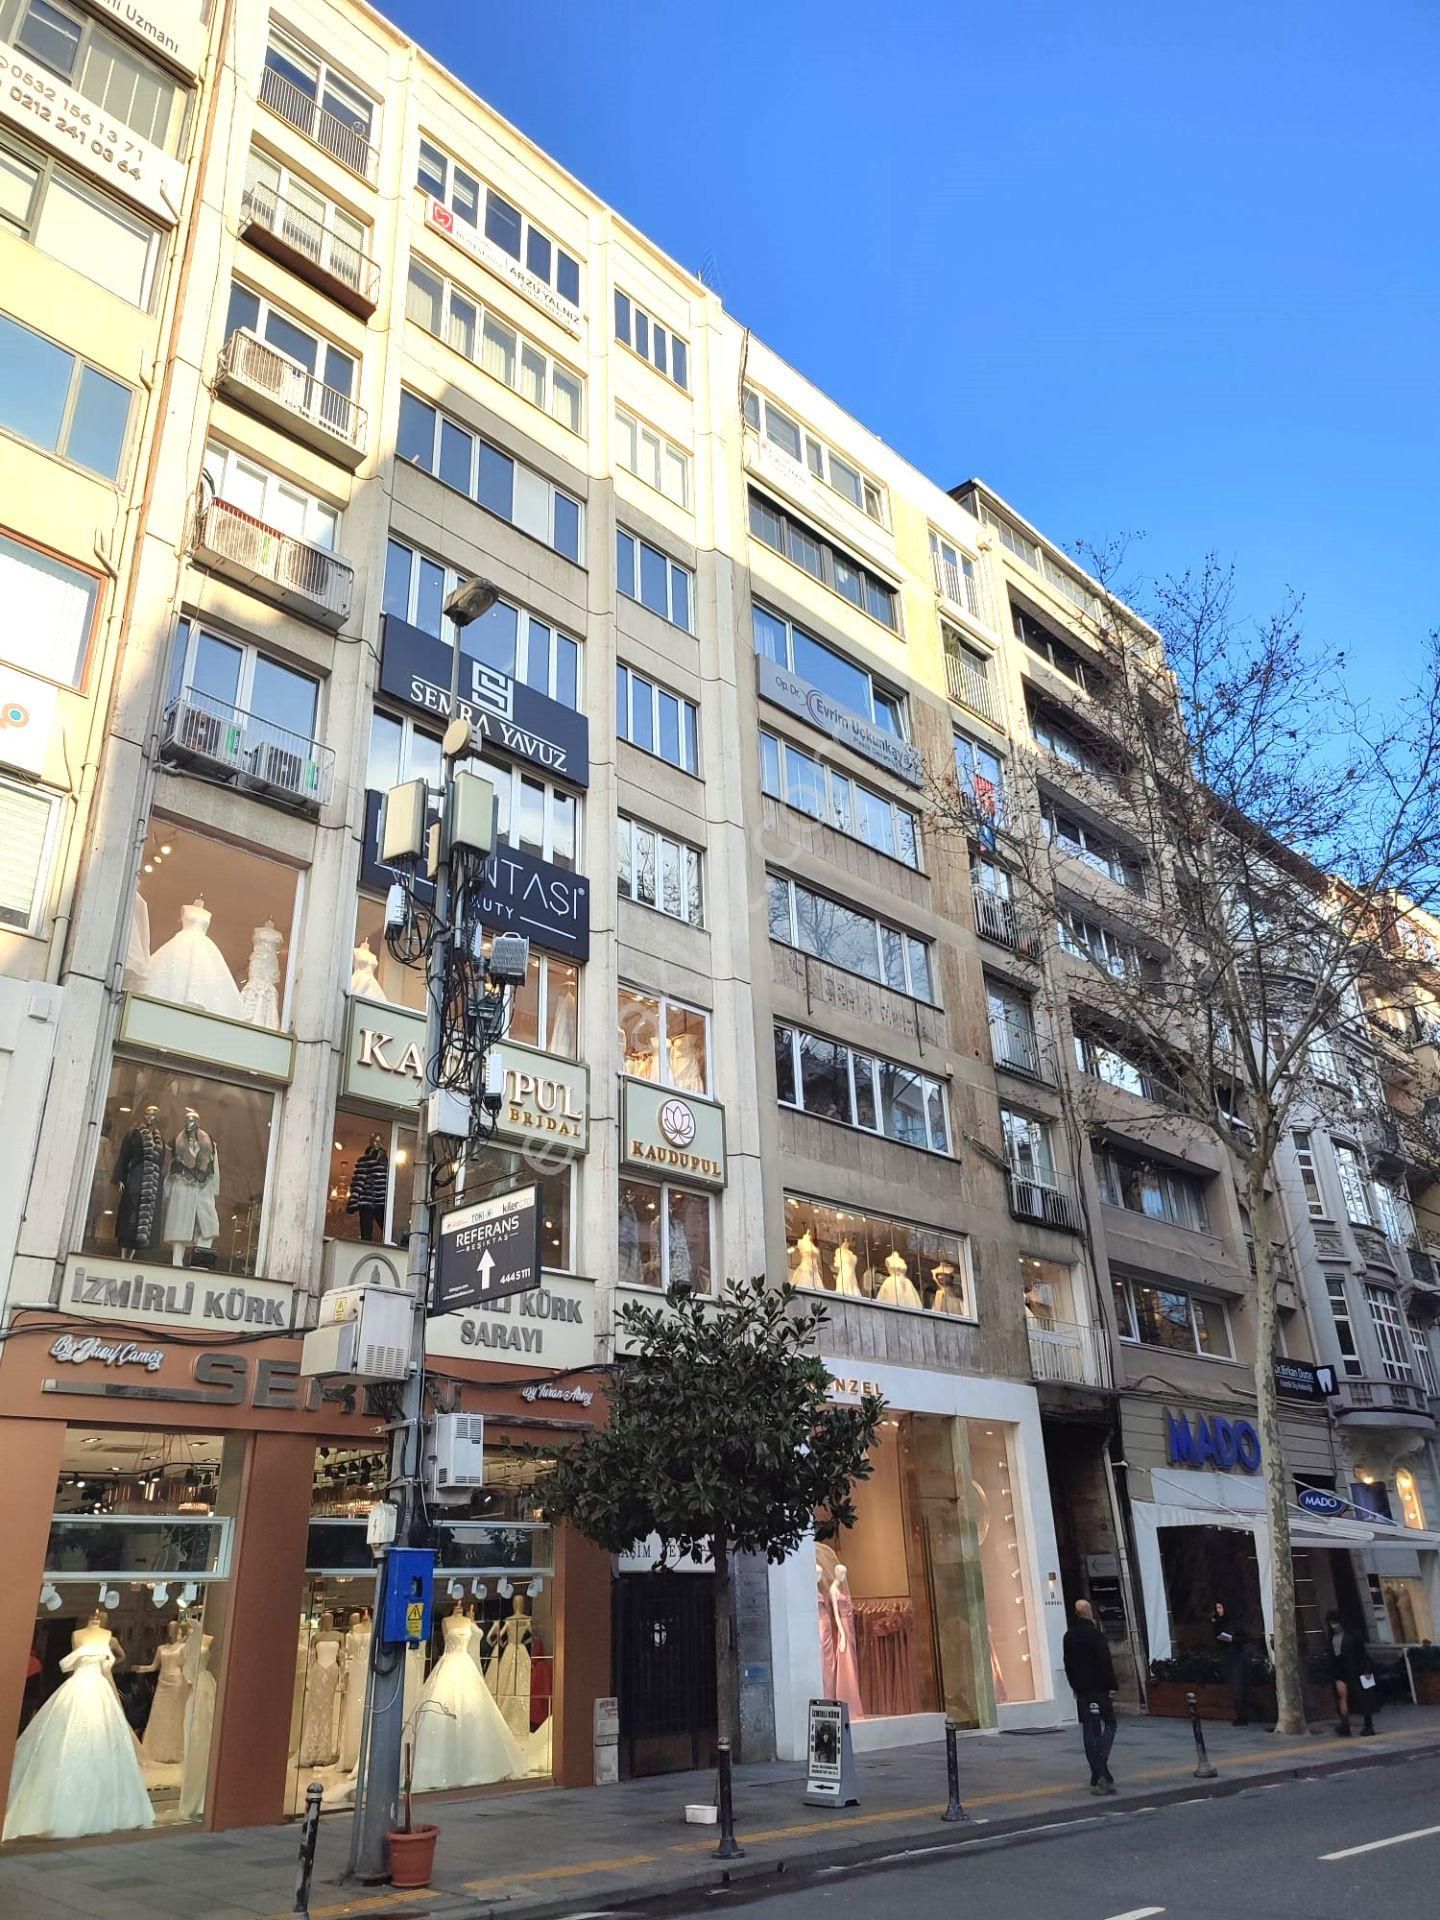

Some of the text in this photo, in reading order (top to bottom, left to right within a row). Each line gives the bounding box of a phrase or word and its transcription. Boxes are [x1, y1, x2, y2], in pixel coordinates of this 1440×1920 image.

[126, 4, 179, 54] Uzmanı
[10, 65, 144, 162] 0532 156 13 71
[9, 85, 142, 182] 0212 241 03 64
[509, 267, 541, 295] ARZU
[816, 698, 849, 730] Evrim
[499, 722, 568, 773] YAVUZ
[508, 1106, 582, 1138] BRIDAL
[631, 1139, 722, 1177] KAUDUPUL
[455, 1214, 521, 1248] REFERANS
[71, 1266, 286, 1326] İZMİRLİ KÜRK
[519, 1288, 584, 1324] KÜRK
[460, 1319, 544, 1354] SARAYI
[1165, 1408, 1263, 1472] MADO
[1305, 1496, 1338, 1508] MADO
